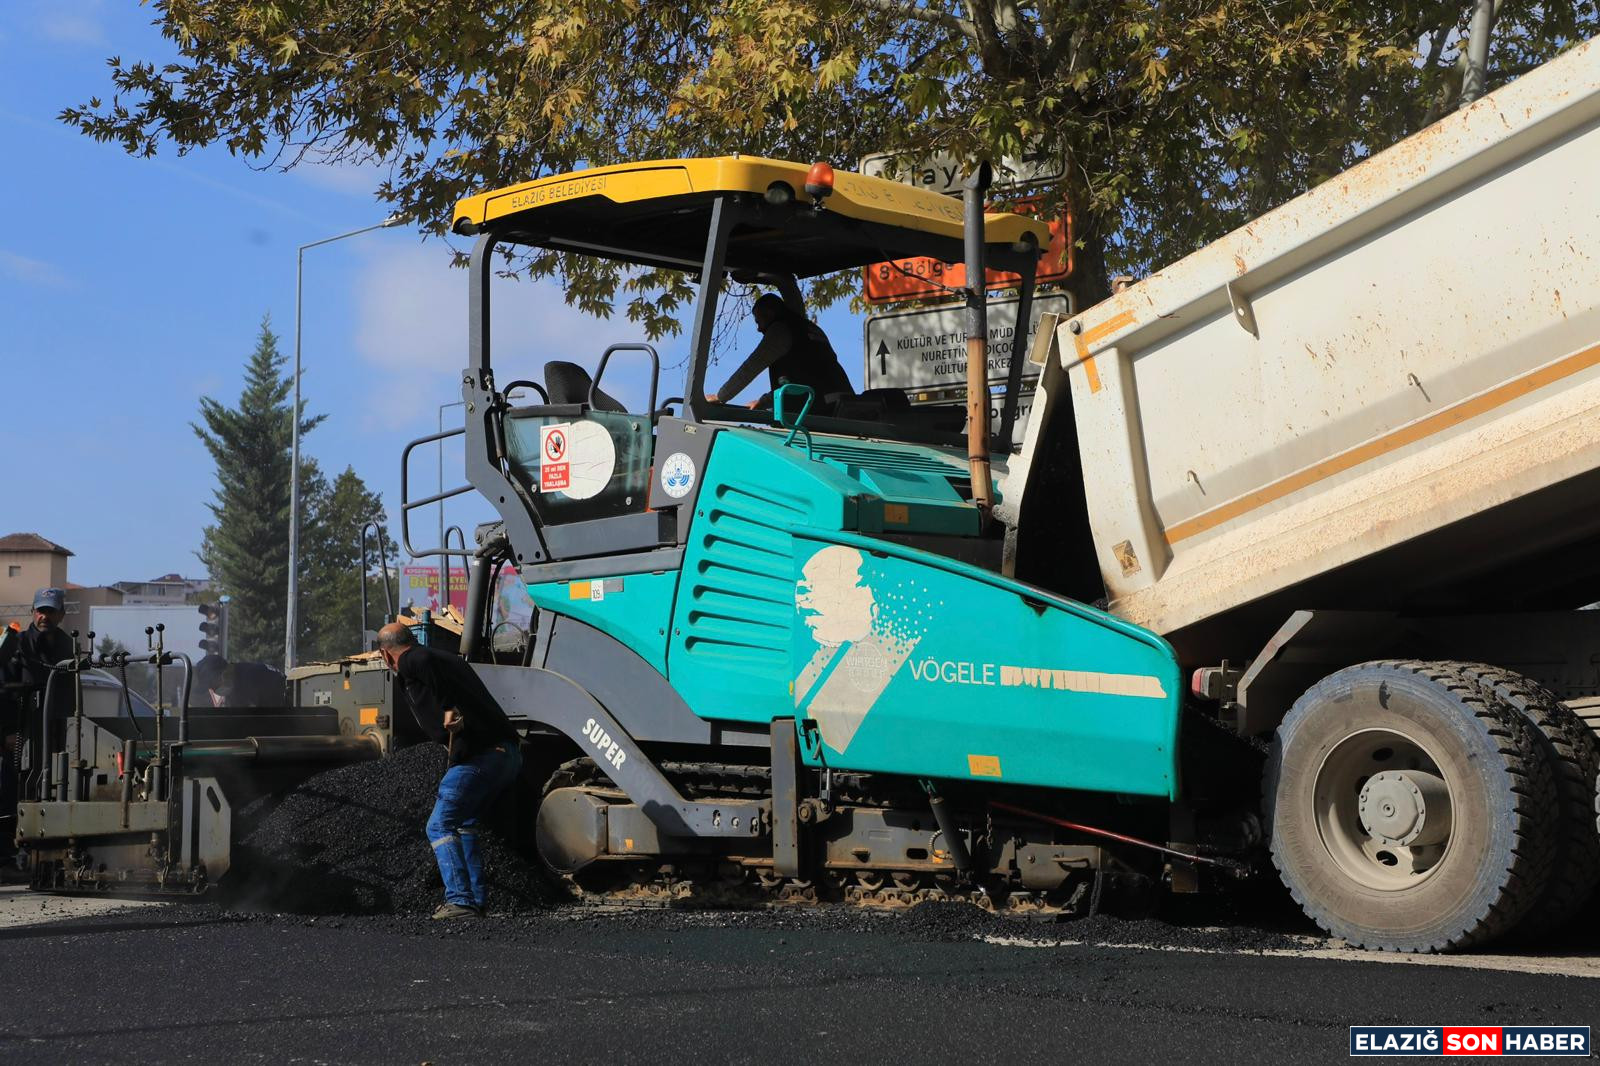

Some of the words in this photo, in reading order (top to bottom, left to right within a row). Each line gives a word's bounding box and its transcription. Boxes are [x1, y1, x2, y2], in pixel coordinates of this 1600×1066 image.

[512, 187, 546, 209] ELAZIĞ
[897, 335, 932, 350] KÜLTÜR
[935, 335, 946, 345] VE
[921, 345, 968, 362] NURETTİN
[908, 656, 995, 686] VÖGELE
[582, 718, 627, 771] SUPER
